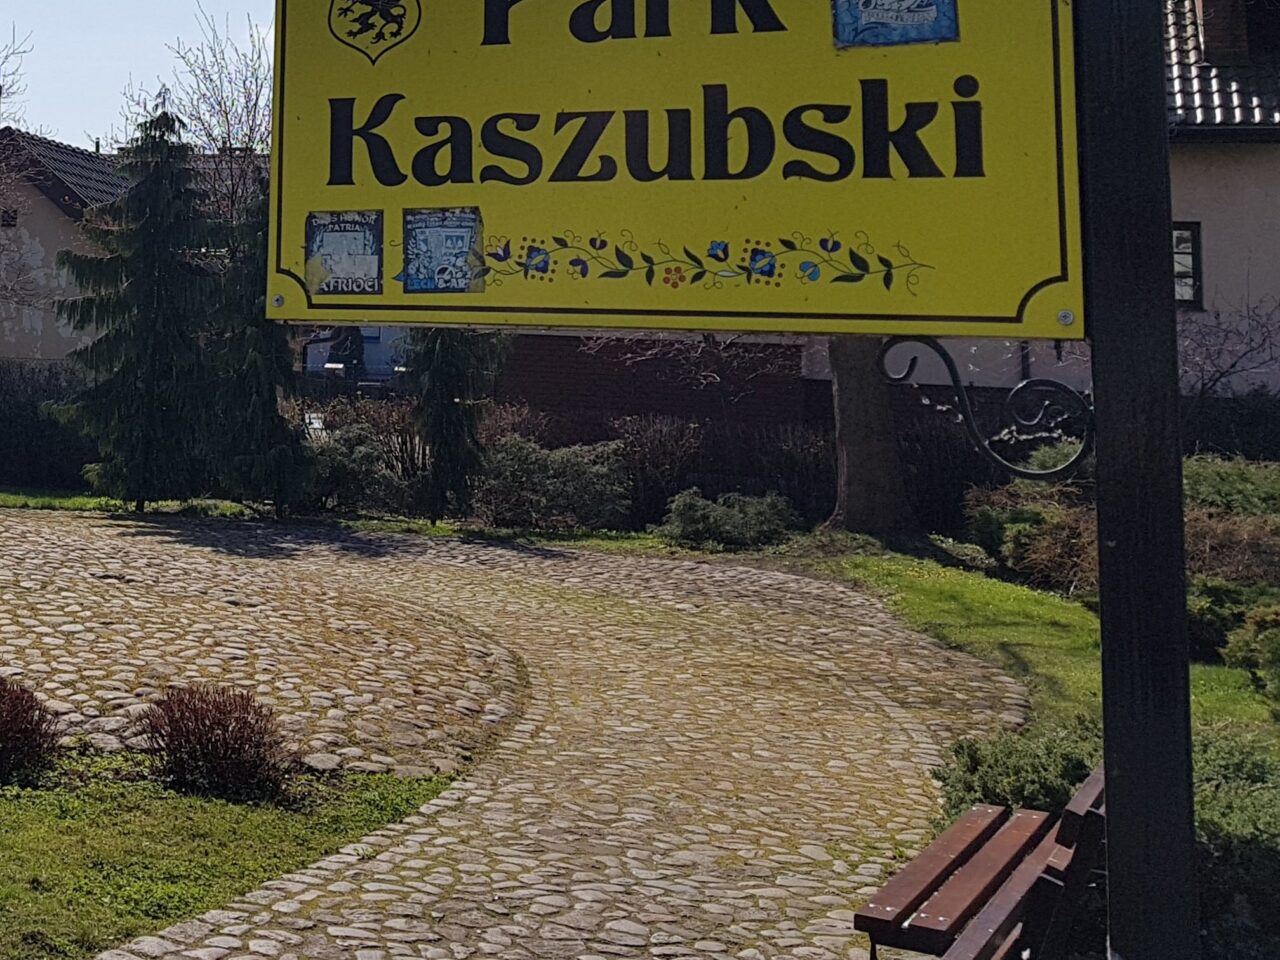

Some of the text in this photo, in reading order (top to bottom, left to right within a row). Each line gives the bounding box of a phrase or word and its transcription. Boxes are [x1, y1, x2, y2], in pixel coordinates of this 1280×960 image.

[326, 75, 986, 187] Kaszubski
[327, 223, 361, 232] PATRIA
[318, 277, 379, 292] ATRIOCI
